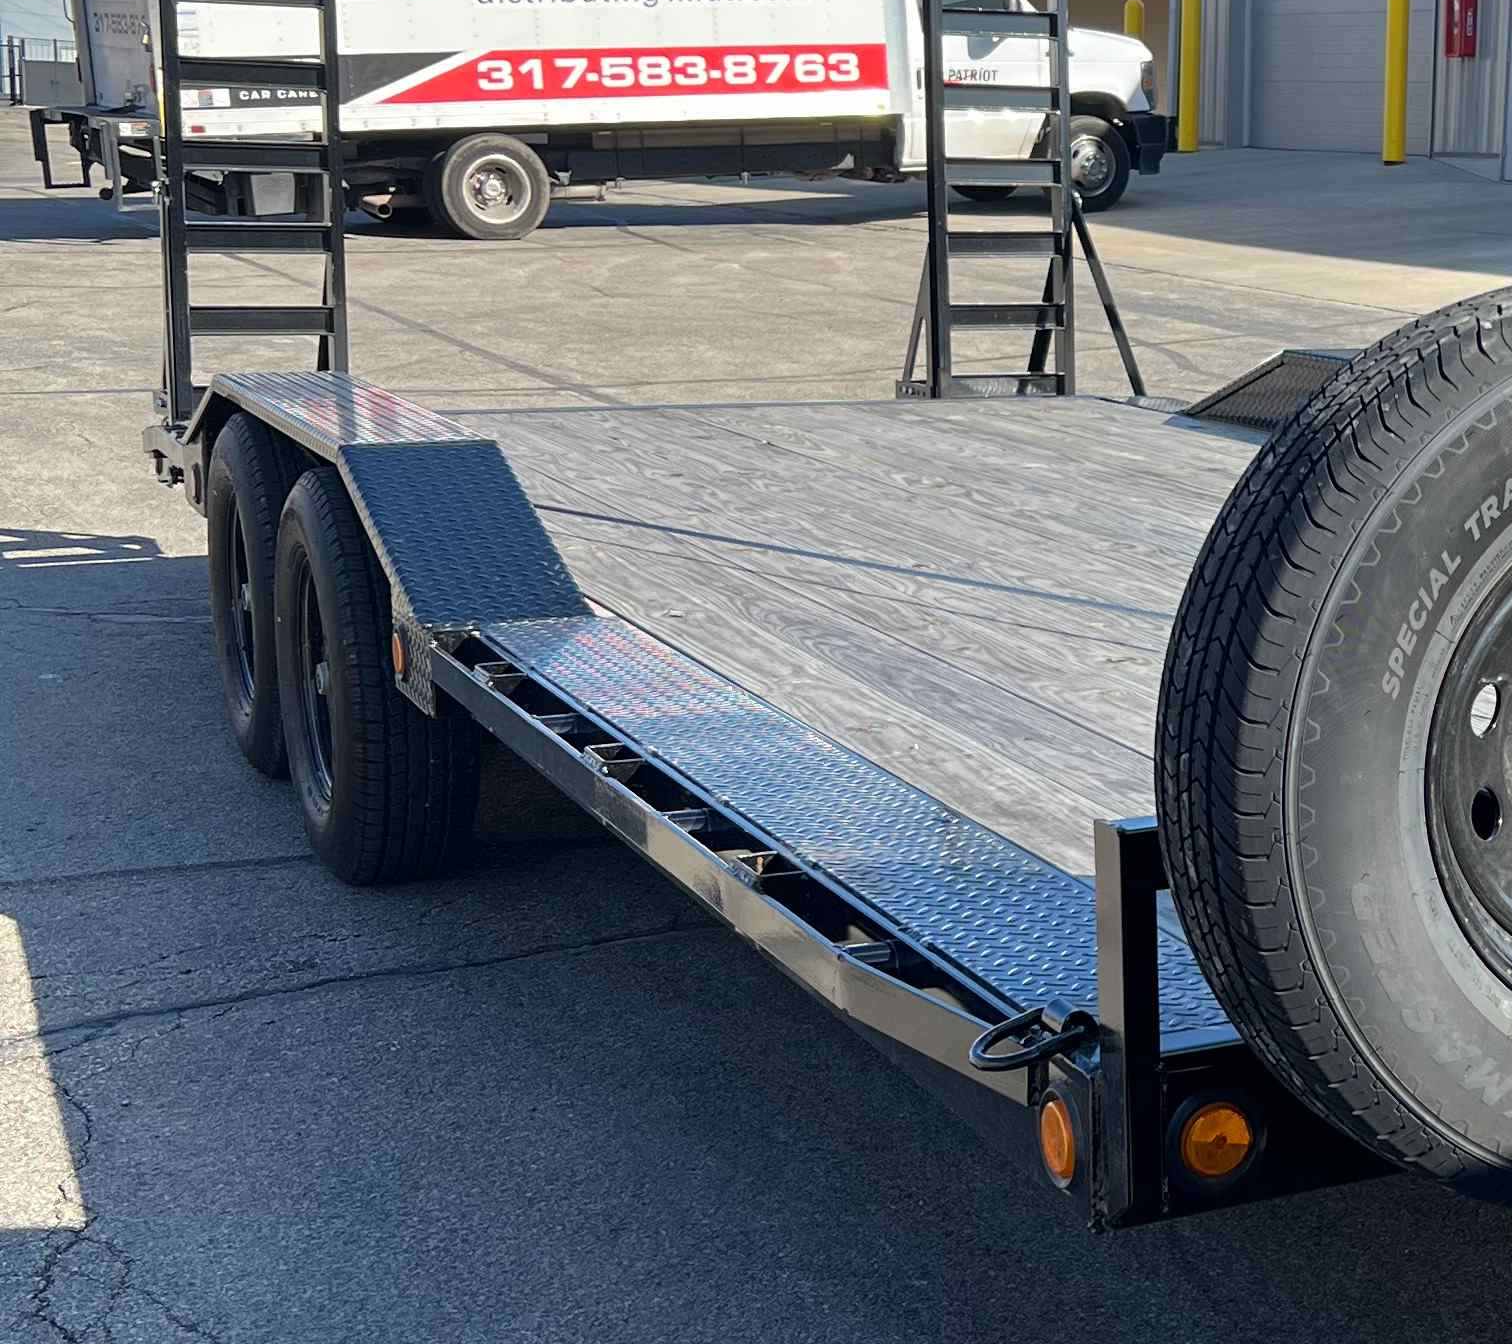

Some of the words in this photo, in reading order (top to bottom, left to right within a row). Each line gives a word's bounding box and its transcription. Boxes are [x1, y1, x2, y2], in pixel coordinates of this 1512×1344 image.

[475, 52, 861, 91] 317-583-8763
[948, 67, 999, 82] PATRIOT
[239, 89, 271, 100] CAR
[1381, 550, 1462, 700] SPECIAL
